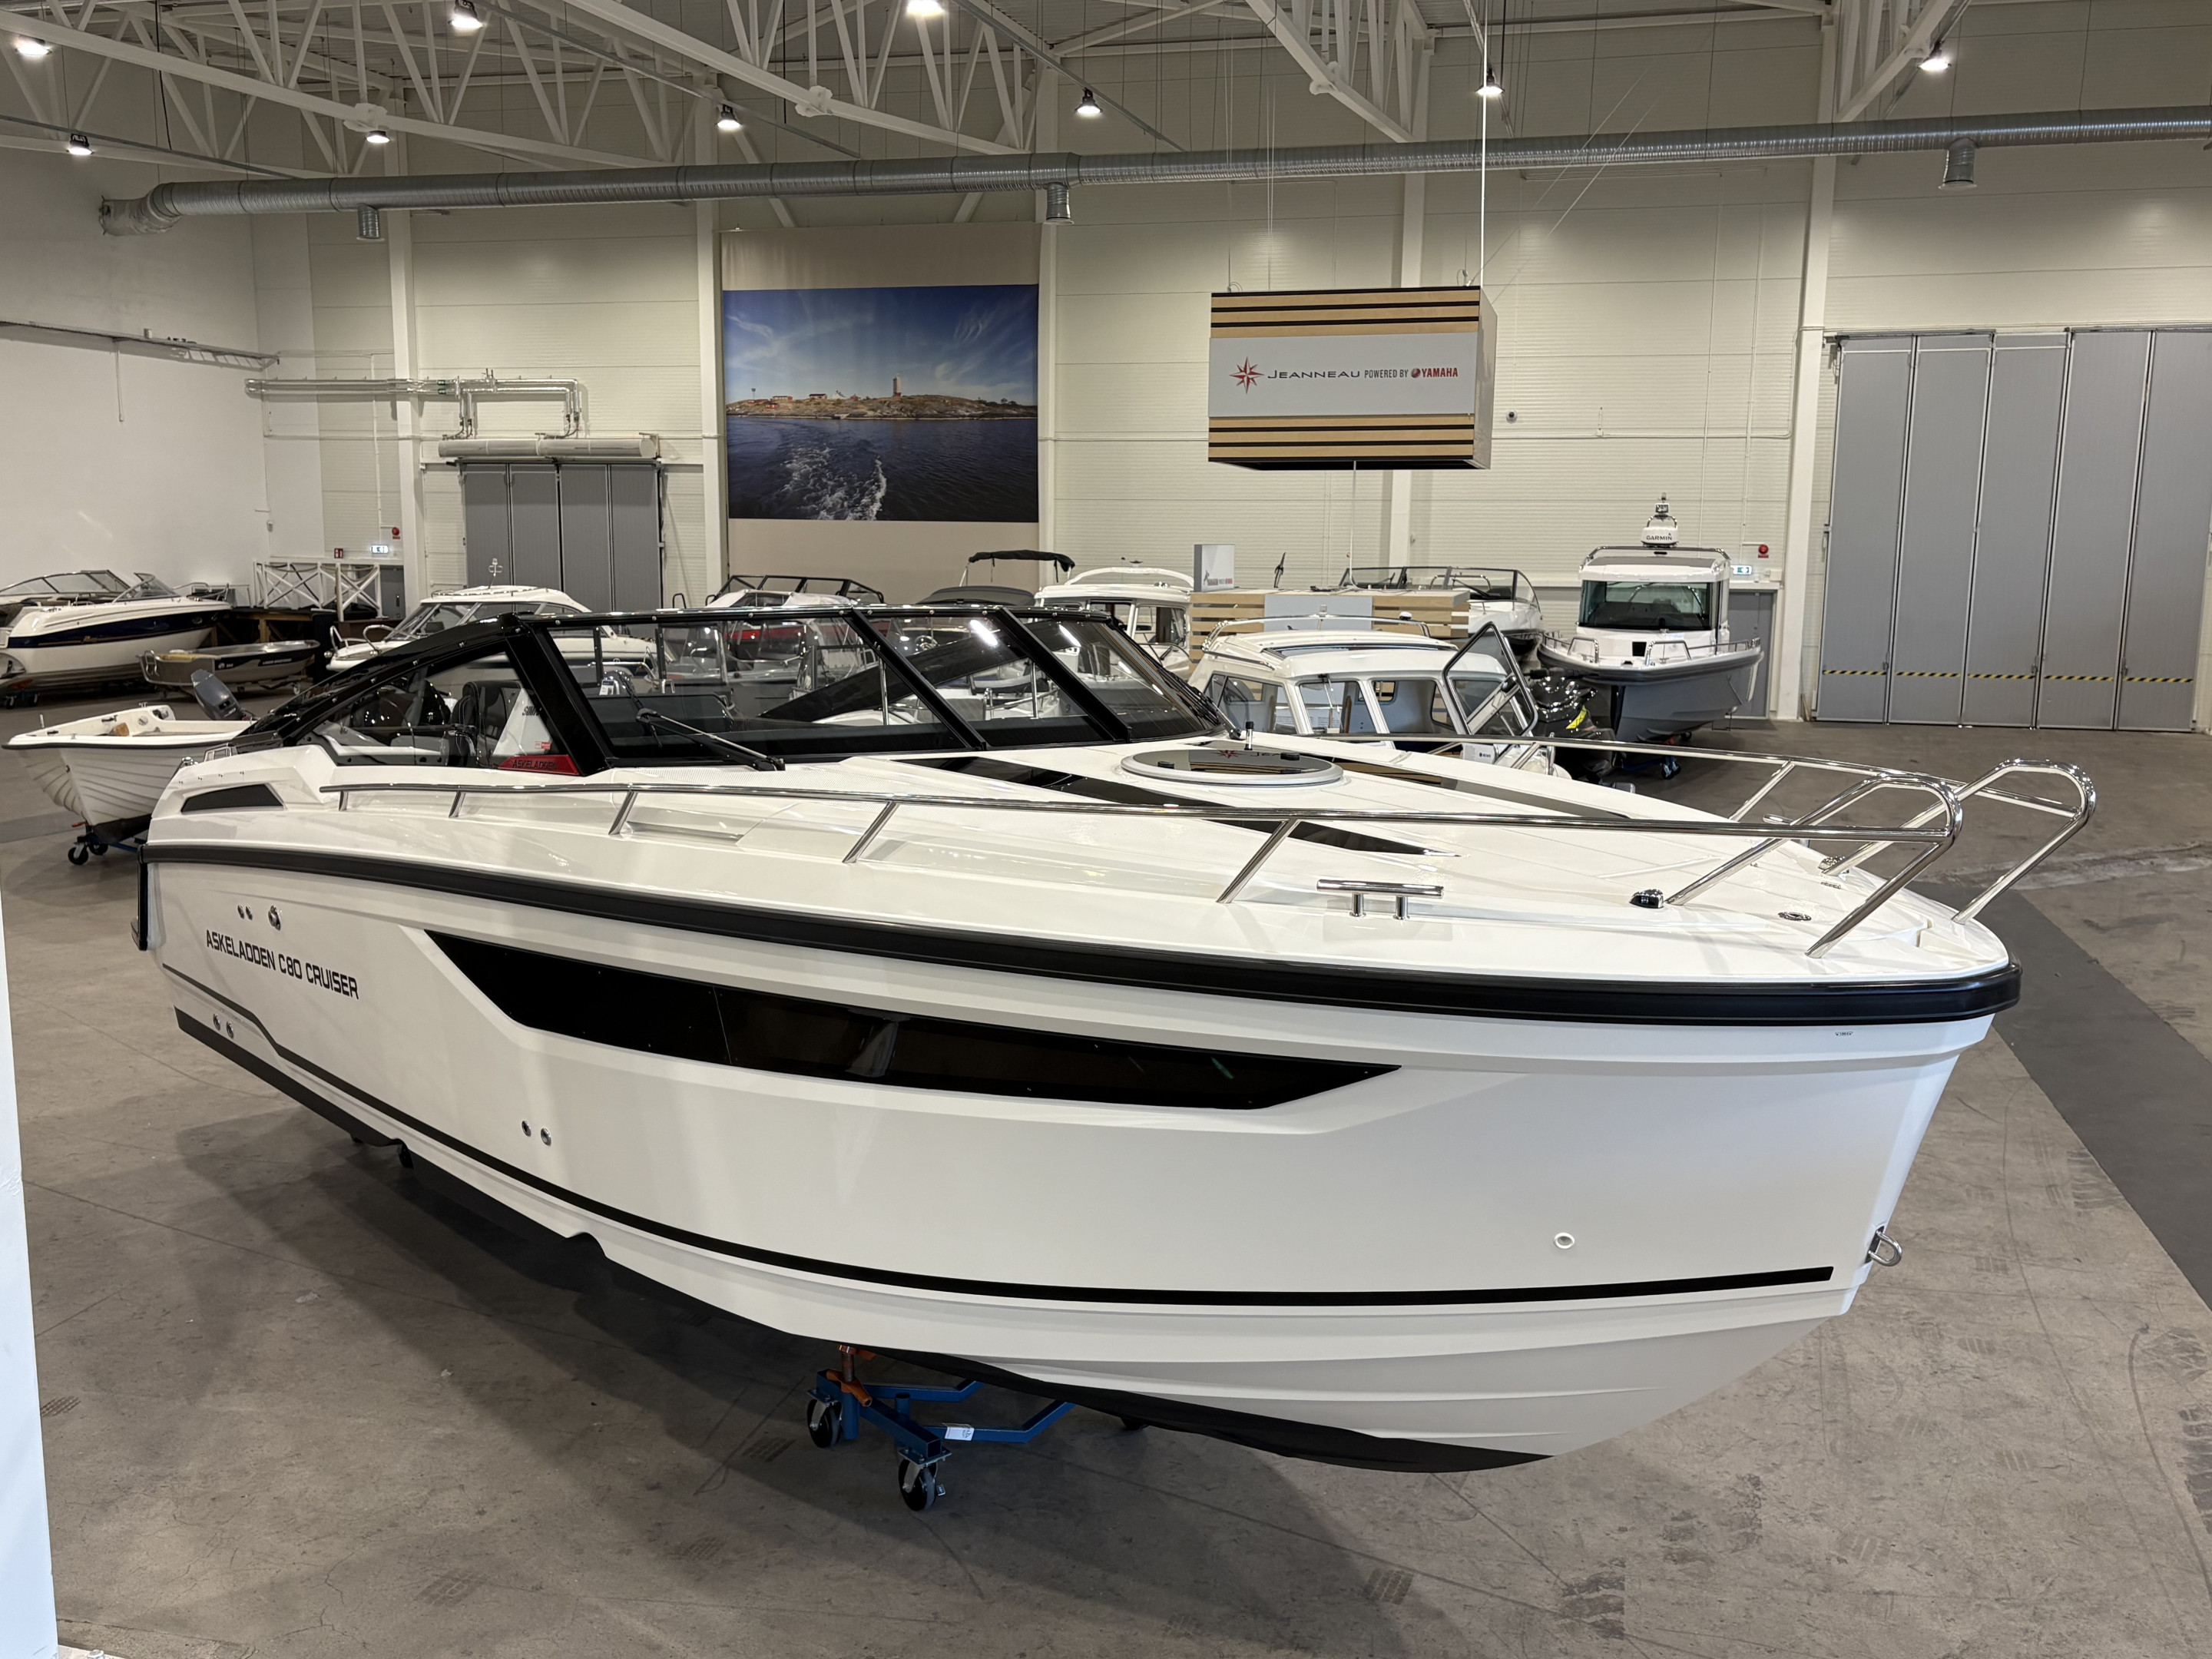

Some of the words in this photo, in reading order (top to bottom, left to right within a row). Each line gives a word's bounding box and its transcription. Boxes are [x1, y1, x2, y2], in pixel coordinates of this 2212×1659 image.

[1267, 369, 1360, 379] JEANNEAU
[1364, 369, 1398, 379] POWERED
[1399, 369, 1409, 378] BY
[1422, 367, 1459, 378] YAMAHA
[206, 929, 276, 971] ASKELADDEN
[278, 953, 303, 979] C80
[306, 962, 359, 1000] CRUISER
